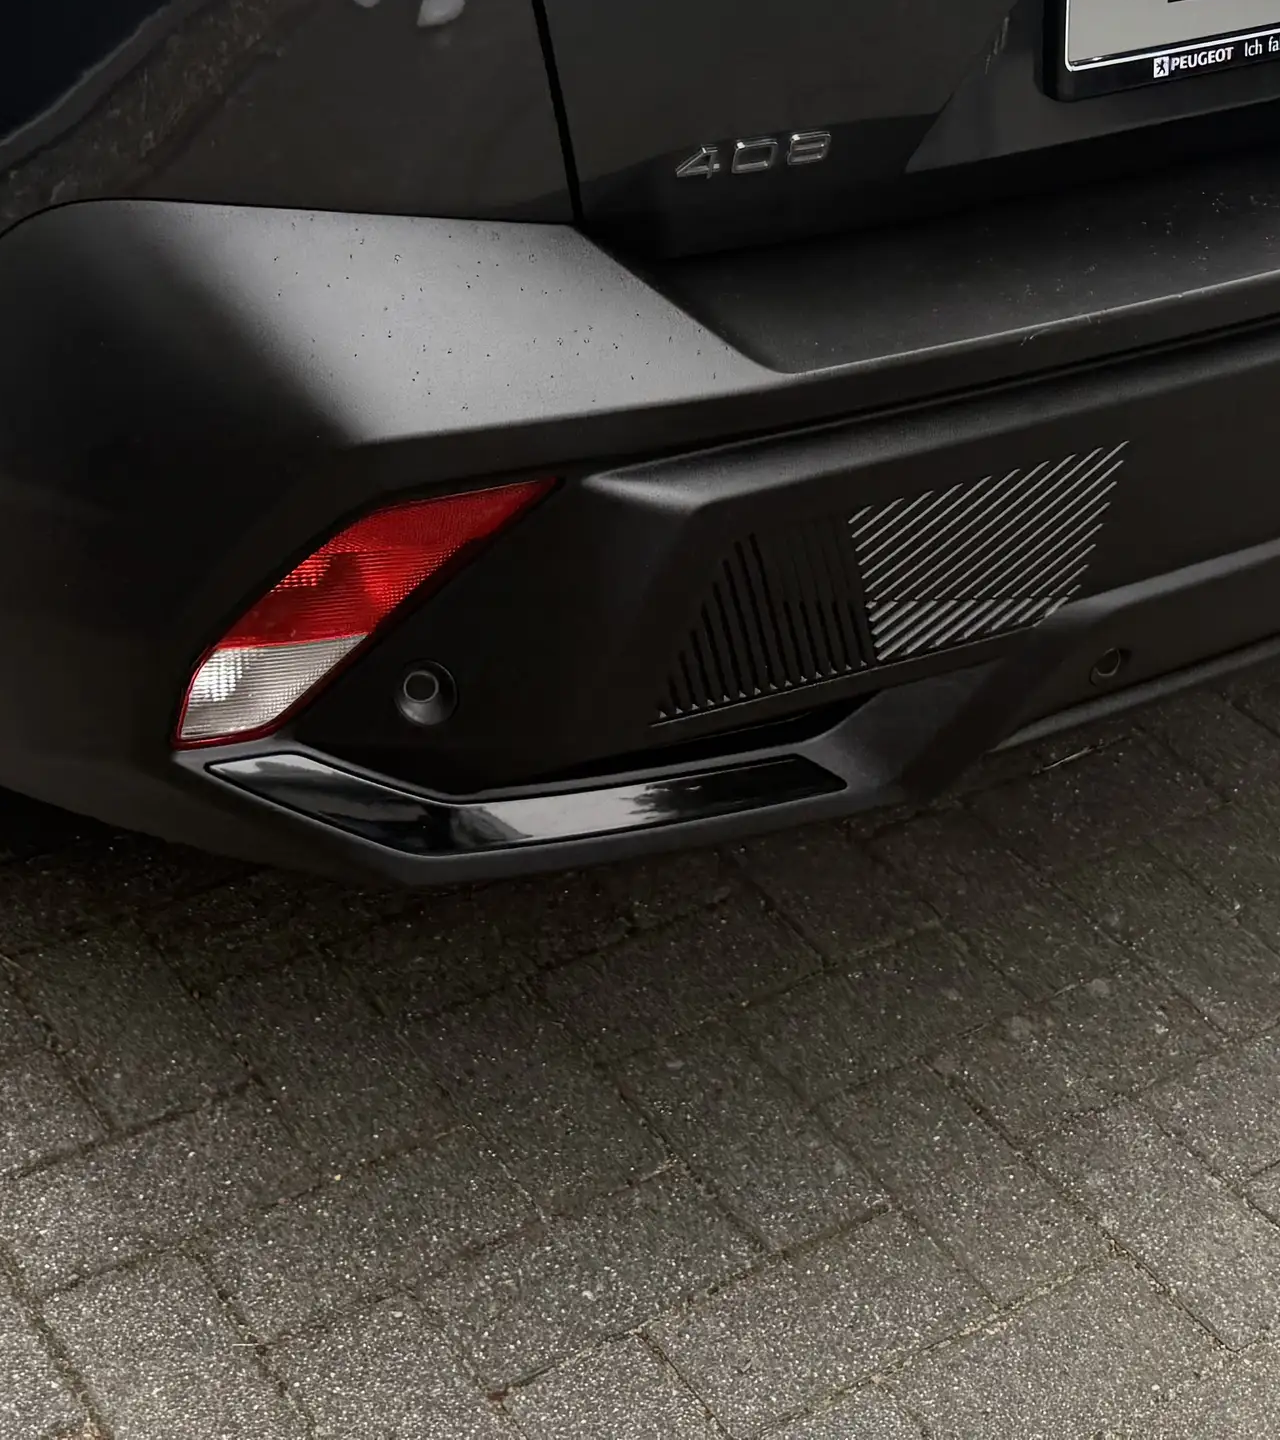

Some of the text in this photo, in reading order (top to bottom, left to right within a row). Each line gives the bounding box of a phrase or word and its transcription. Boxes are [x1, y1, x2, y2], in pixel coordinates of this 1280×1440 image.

[1171, 46, 1234, 71] PEUGEOT
[1244, 40, 1263, 57] Ich
[675, 131, 831, 179] 408
